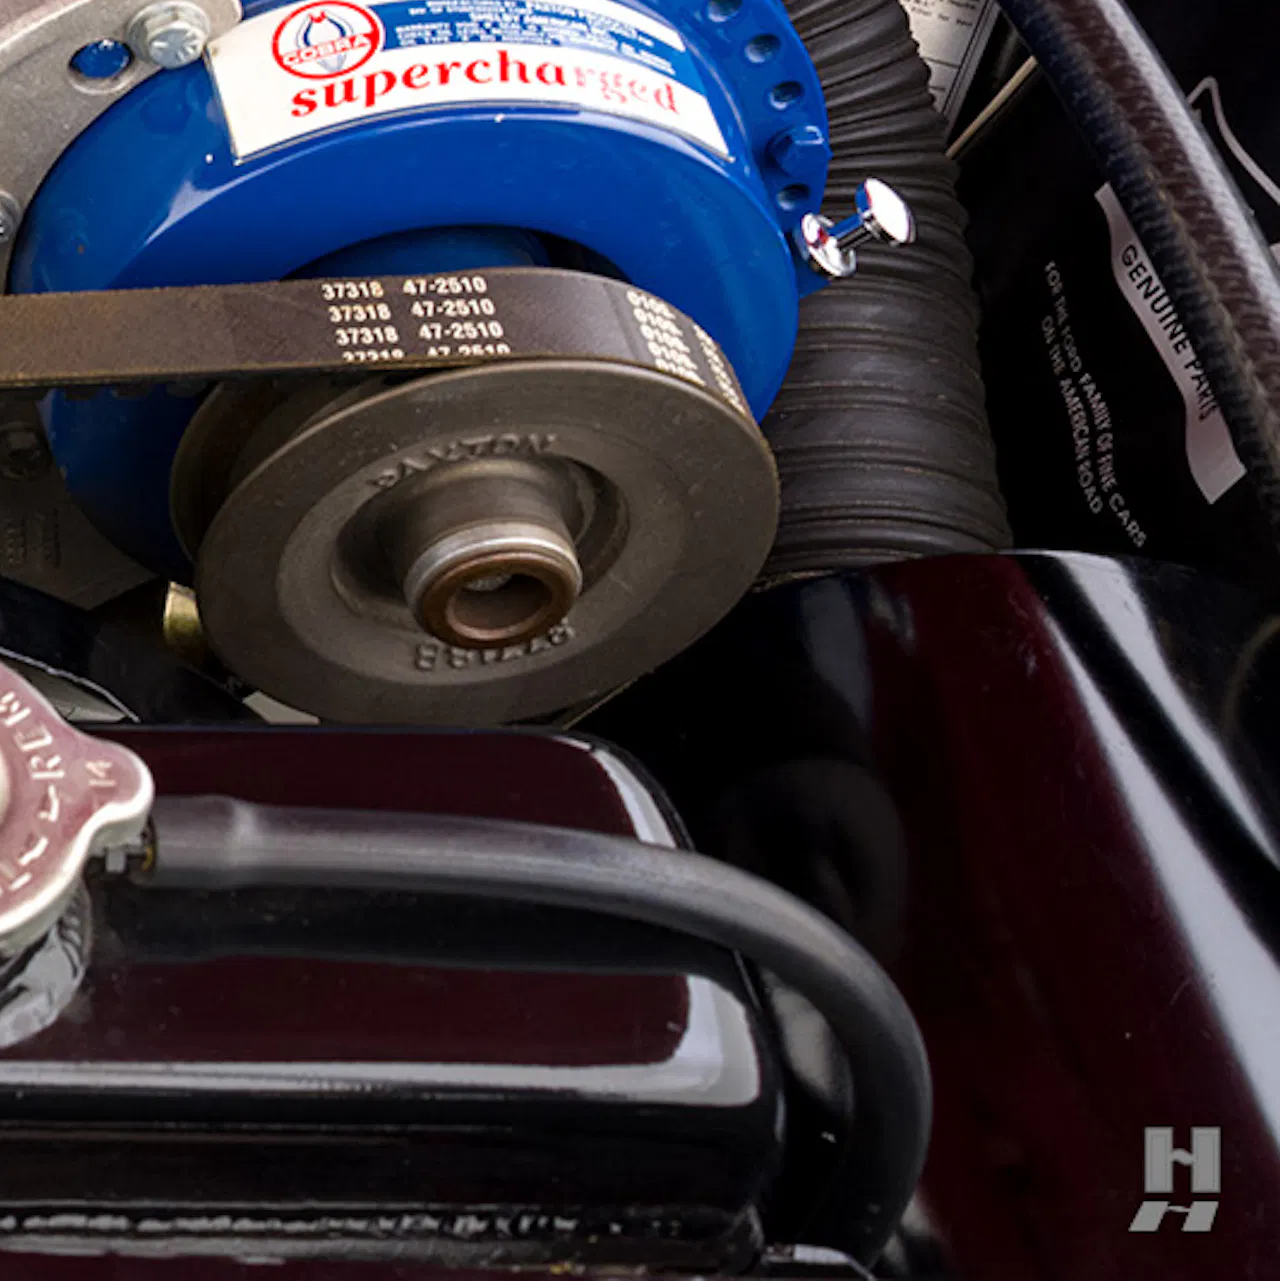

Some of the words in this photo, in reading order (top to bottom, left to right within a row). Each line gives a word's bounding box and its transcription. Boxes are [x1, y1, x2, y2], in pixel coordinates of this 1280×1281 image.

[283, 34, 371, 65] COBRA
[290, 50, 680, 118] supercharged
[321, 280, 384, 301] 37318
[1120, 244, 1190, 354] GENUINE
[328, 302, 392, 323] 37318
[335, 324, 400, 346] 37318
[1108, 492, 1147, 548] CARS
